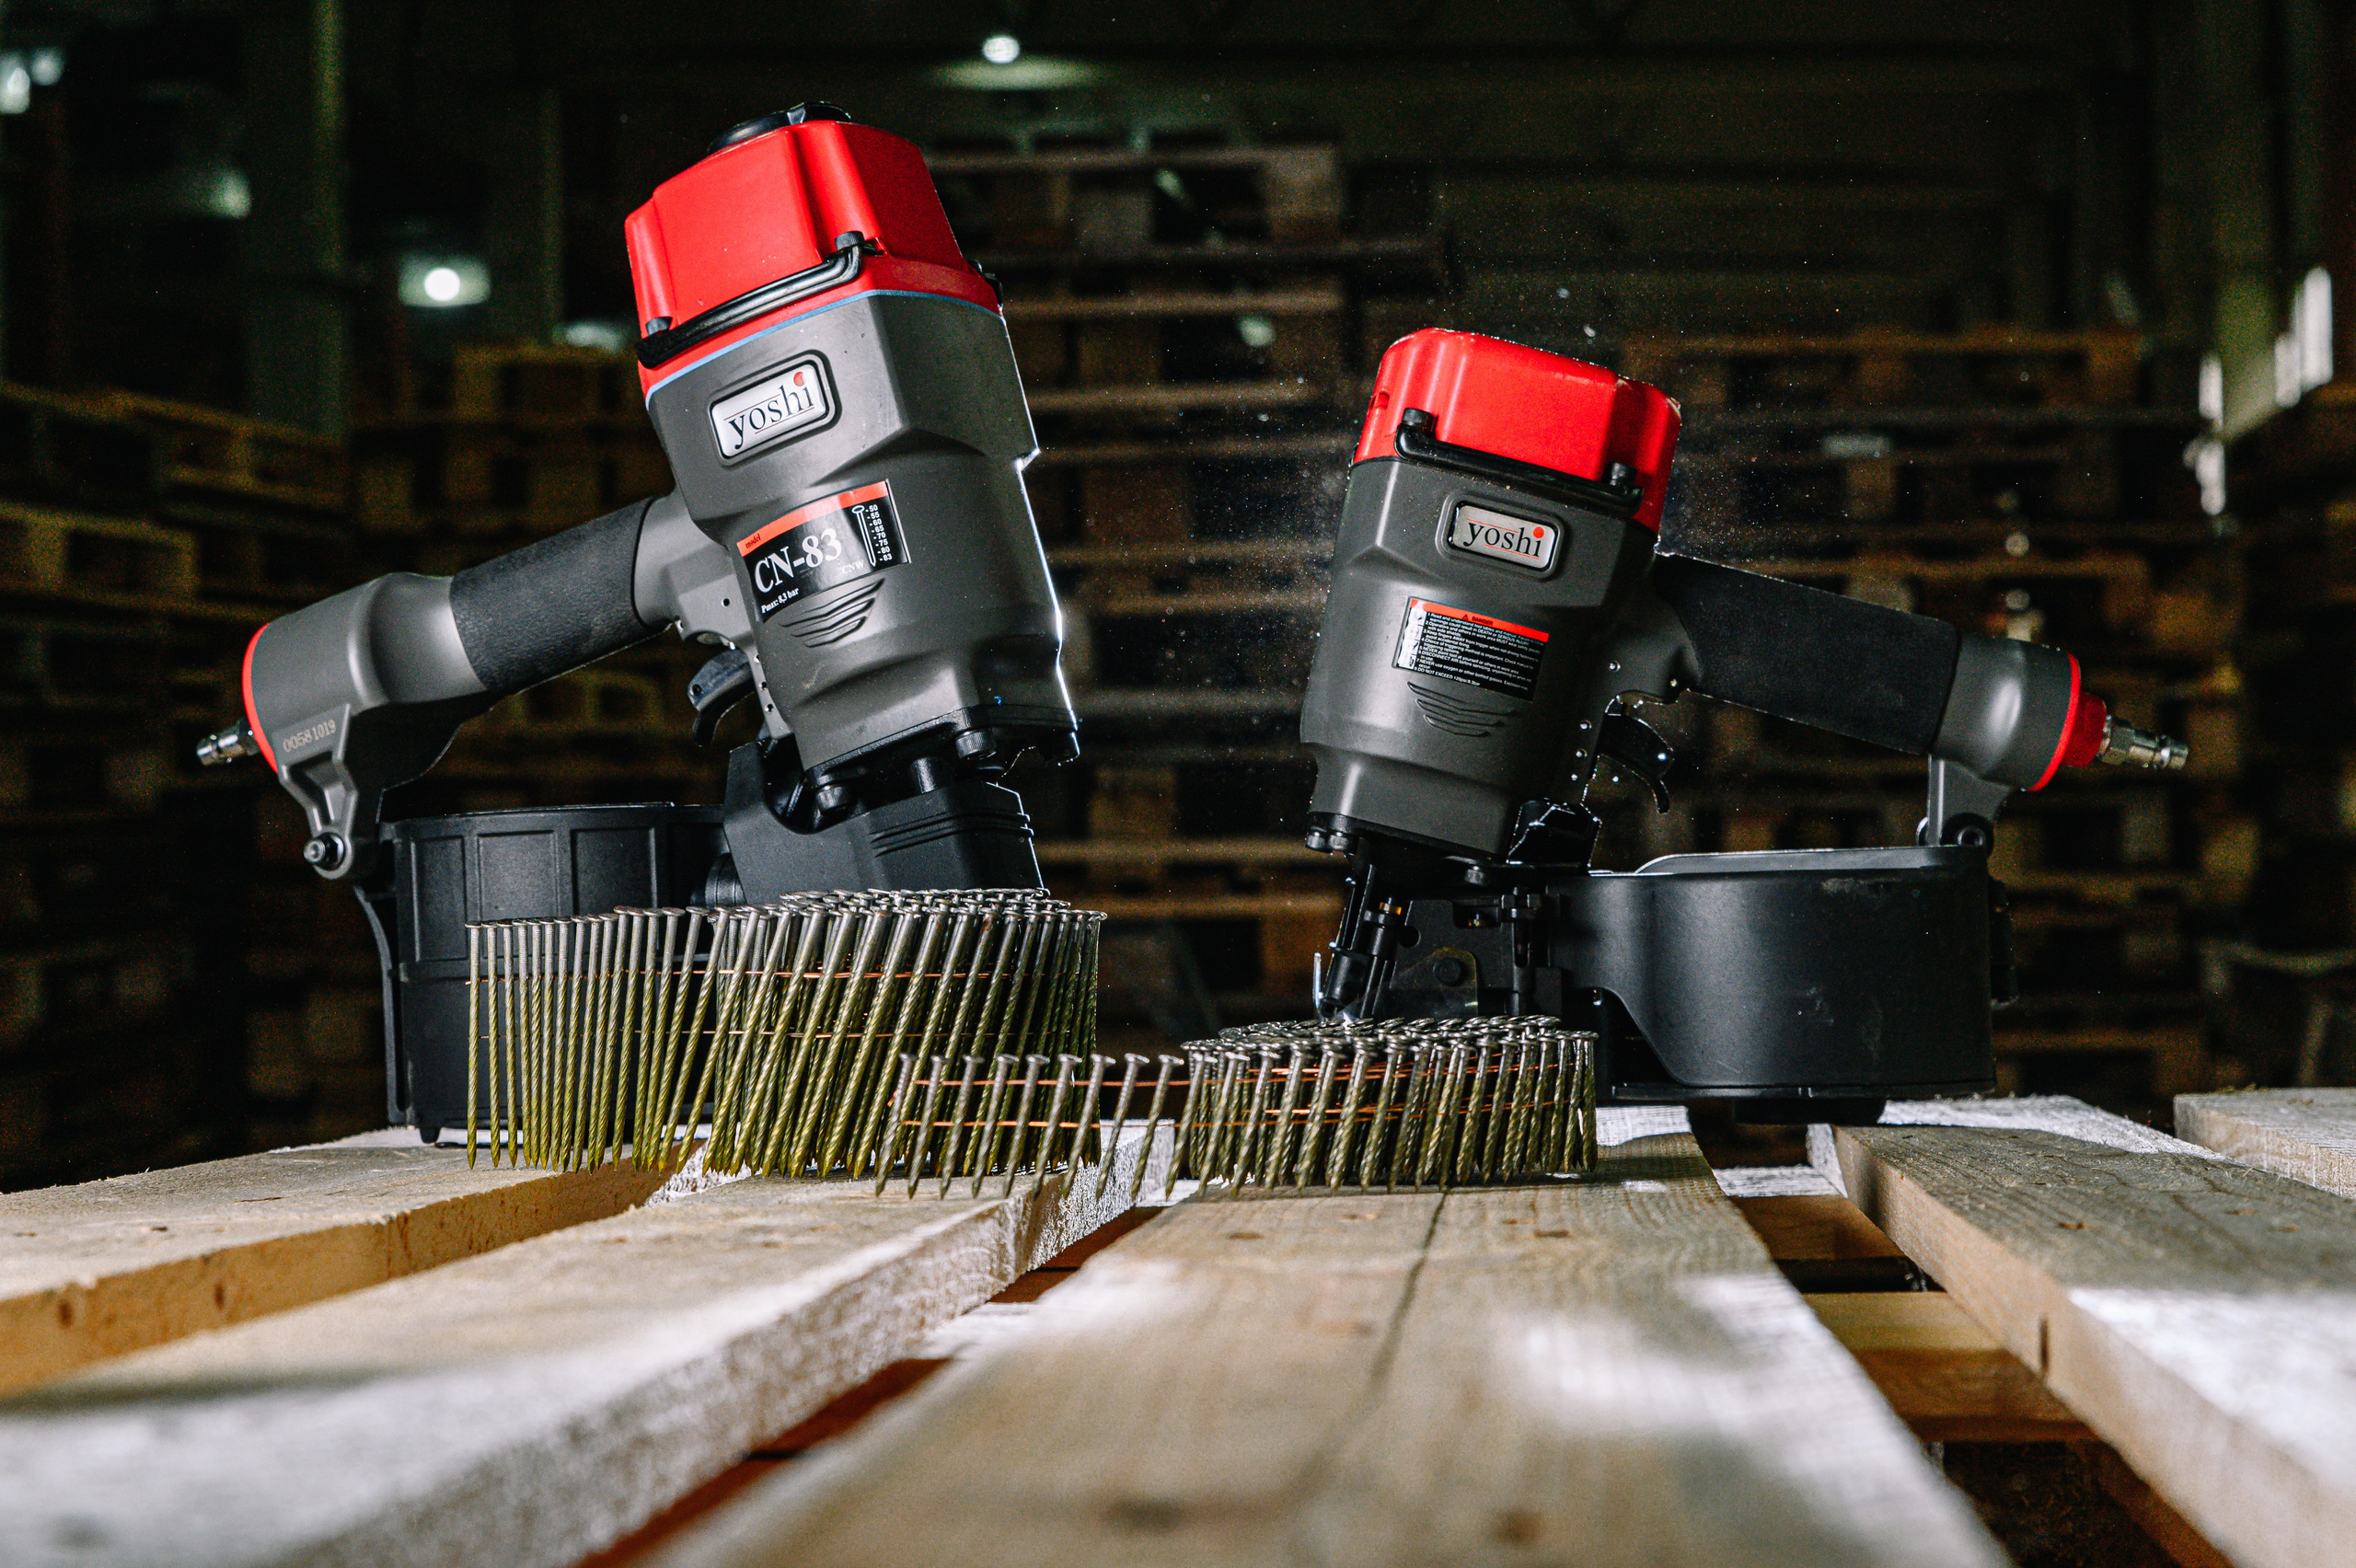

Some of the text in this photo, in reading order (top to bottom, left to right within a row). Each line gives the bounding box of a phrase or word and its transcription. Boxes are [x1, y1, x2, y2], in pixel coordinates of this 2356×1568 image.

[728, 371, 814, 450] yoshi
[745, 534, 761, 549] model
[1462, 522, 1544, 558] yoshi
[755, 528, 842, 593] CN-83
[842, 559, 865, 574] CNW
[761, 599, 779, 614] Pmax:
[787, 588, 799, 599] bar
[1451, 618, 1474, 627] understand
[1471, 616, 1493, 625] DANGER
[1438, 637, 1459, 645] accidental
[1445, 643, 1464, 651] triggering
[1435, 671, 1453, 679] EXCEED
